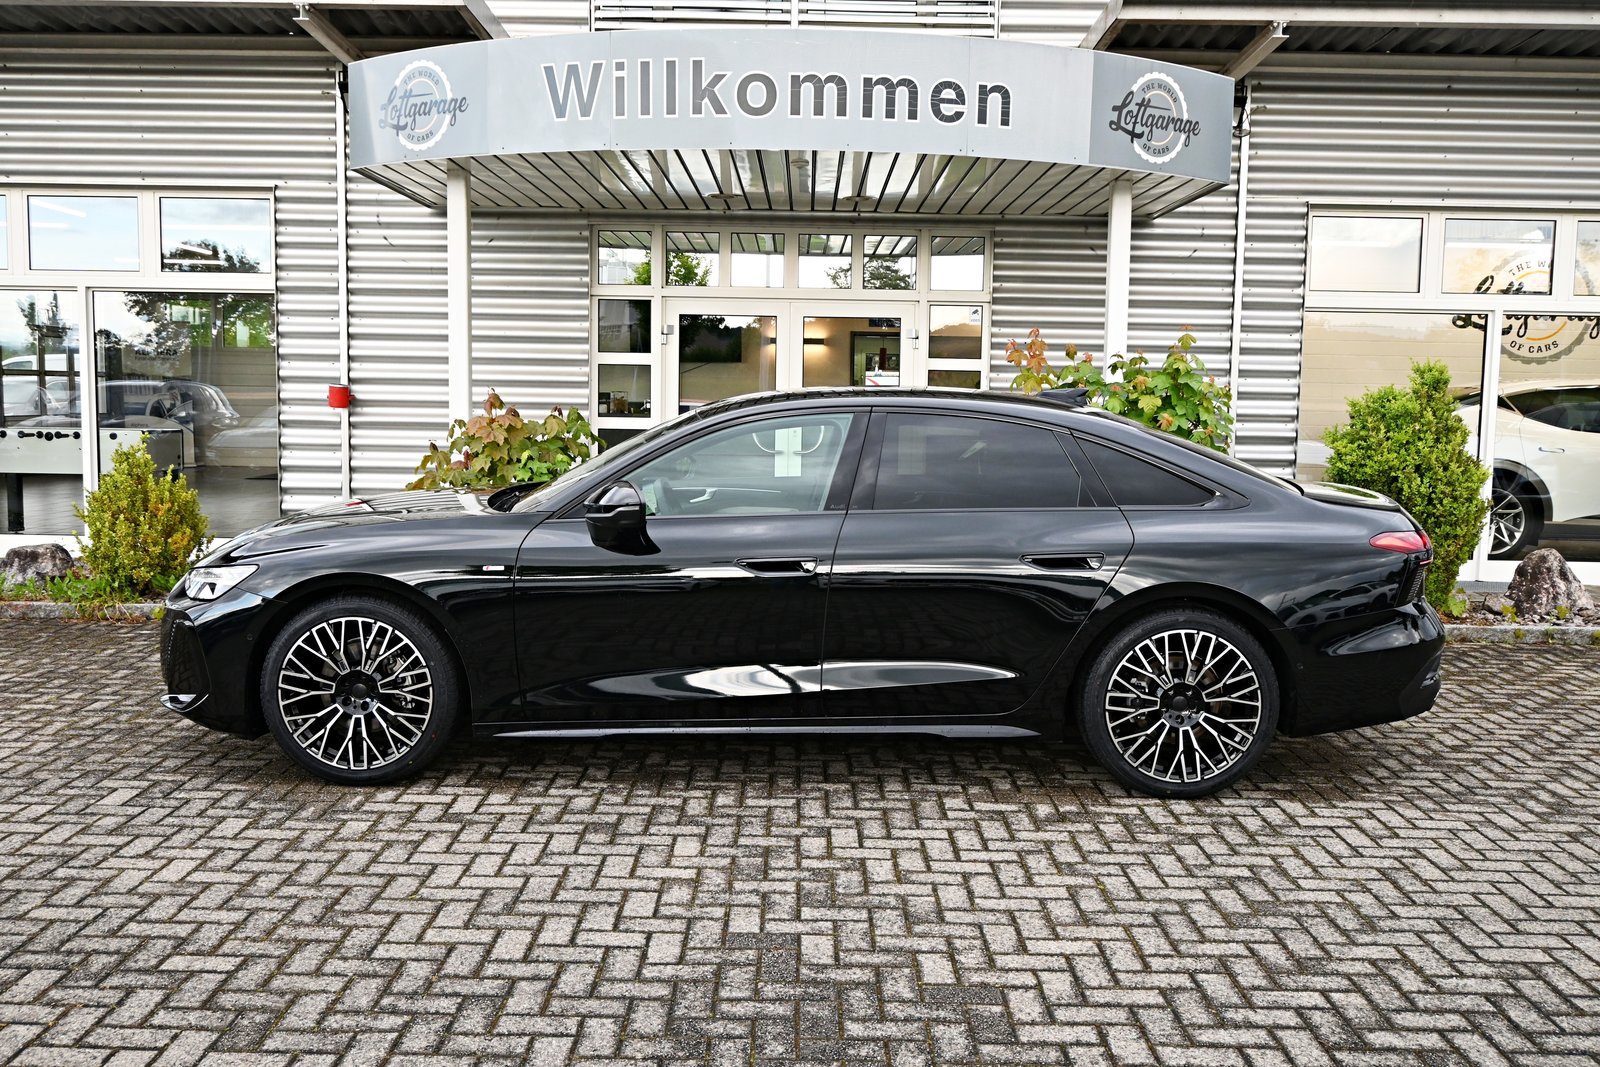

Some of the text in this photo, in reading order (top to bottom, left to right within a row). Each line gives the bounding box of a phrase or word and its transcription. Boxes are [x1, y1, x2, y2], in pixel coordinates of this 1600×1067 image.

[418, 70, 440, 86] WORLD
[542, 57, 1013, 130] Willkommen
[1142, 82, 1178, 103] THE WORLD
[379, 86, 469, 137] Loftgarage
[1109, 91, 1201, 147] Loftgarage
[416, 131, 434, 142] CARS
[1142, 143, 1170, 155] OF CARS
[1508, 261, 1532, 276] THE
[1510, 340, 1559, 354] OF CARS
